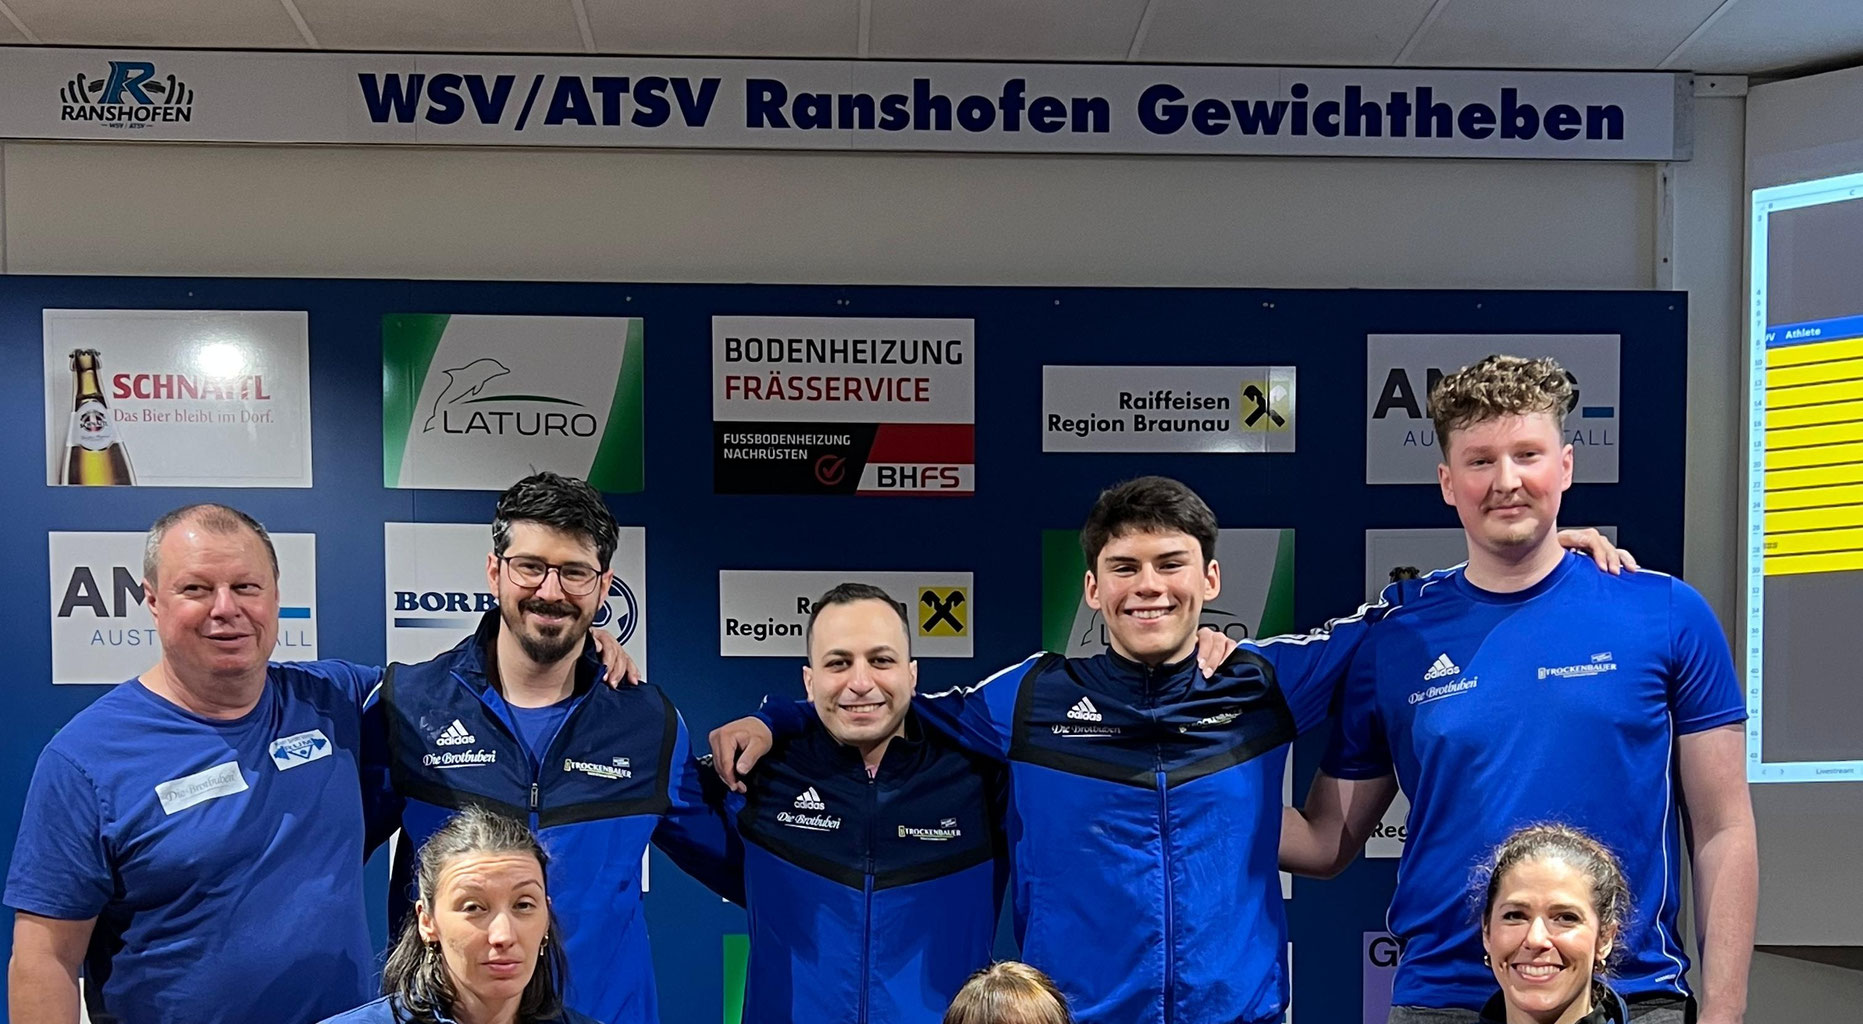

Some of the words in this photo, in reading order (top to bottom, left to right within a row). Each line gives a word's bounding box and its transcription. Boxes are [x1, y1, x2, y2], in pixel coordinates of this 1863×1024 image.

[61, 105, 192, 122] RANSHOFEN
[358, 73, 721, 130] WSV/ATSV
[746, 78, 1110, 133] Ranshofen
[1137, 83, 1624, 140] Gewichtheben
[1785, 328, 1821, 340] Athlete
[725, 338, 963, 365] BODENHEIZUNG
[725, 371, 930, 402] FRÄSSERVICE
[1119, 391, 1230, 411] Raiffeisen
[114, 409, 138, 423] Das
[142, 409, 171, 423] Bier
[175, 409, 212, 423] bleibt
[218, 411, 235, 423] im
[240, 410, 274, 424] Dorf.
[443, 410, 597, 437] LATURO
[1048, 413, 1124, 437] Region
[1133, 415, 1230, 432] Braunau
[723, 433, 851, 446] FUSSBODENHEIZUNG
[723, 447, 808, 461] NACHRÜSTEN
[877, 466, 960, 488] BHFS
[726, 617, 802, 641] Region
[1424, 665, 1460, 681] adidas
[1546, 663, 1617, 677] TROCKENBAUER
[1408, 690, 1425, 705] Die
[1426, 676, 1478, 699] Brotbuben
[1067, 710, 1102, 722] adidas
[436, 735, 475, 746] adidas
[423, 752, 440, 767] Die
[442, 749, 496, 765] Brotbuben
[571, 761, 632, 779] TROCKENBAUER
[794, 801, 825, 810] adidas
[795, 814, 842, 829] Brotbuben
